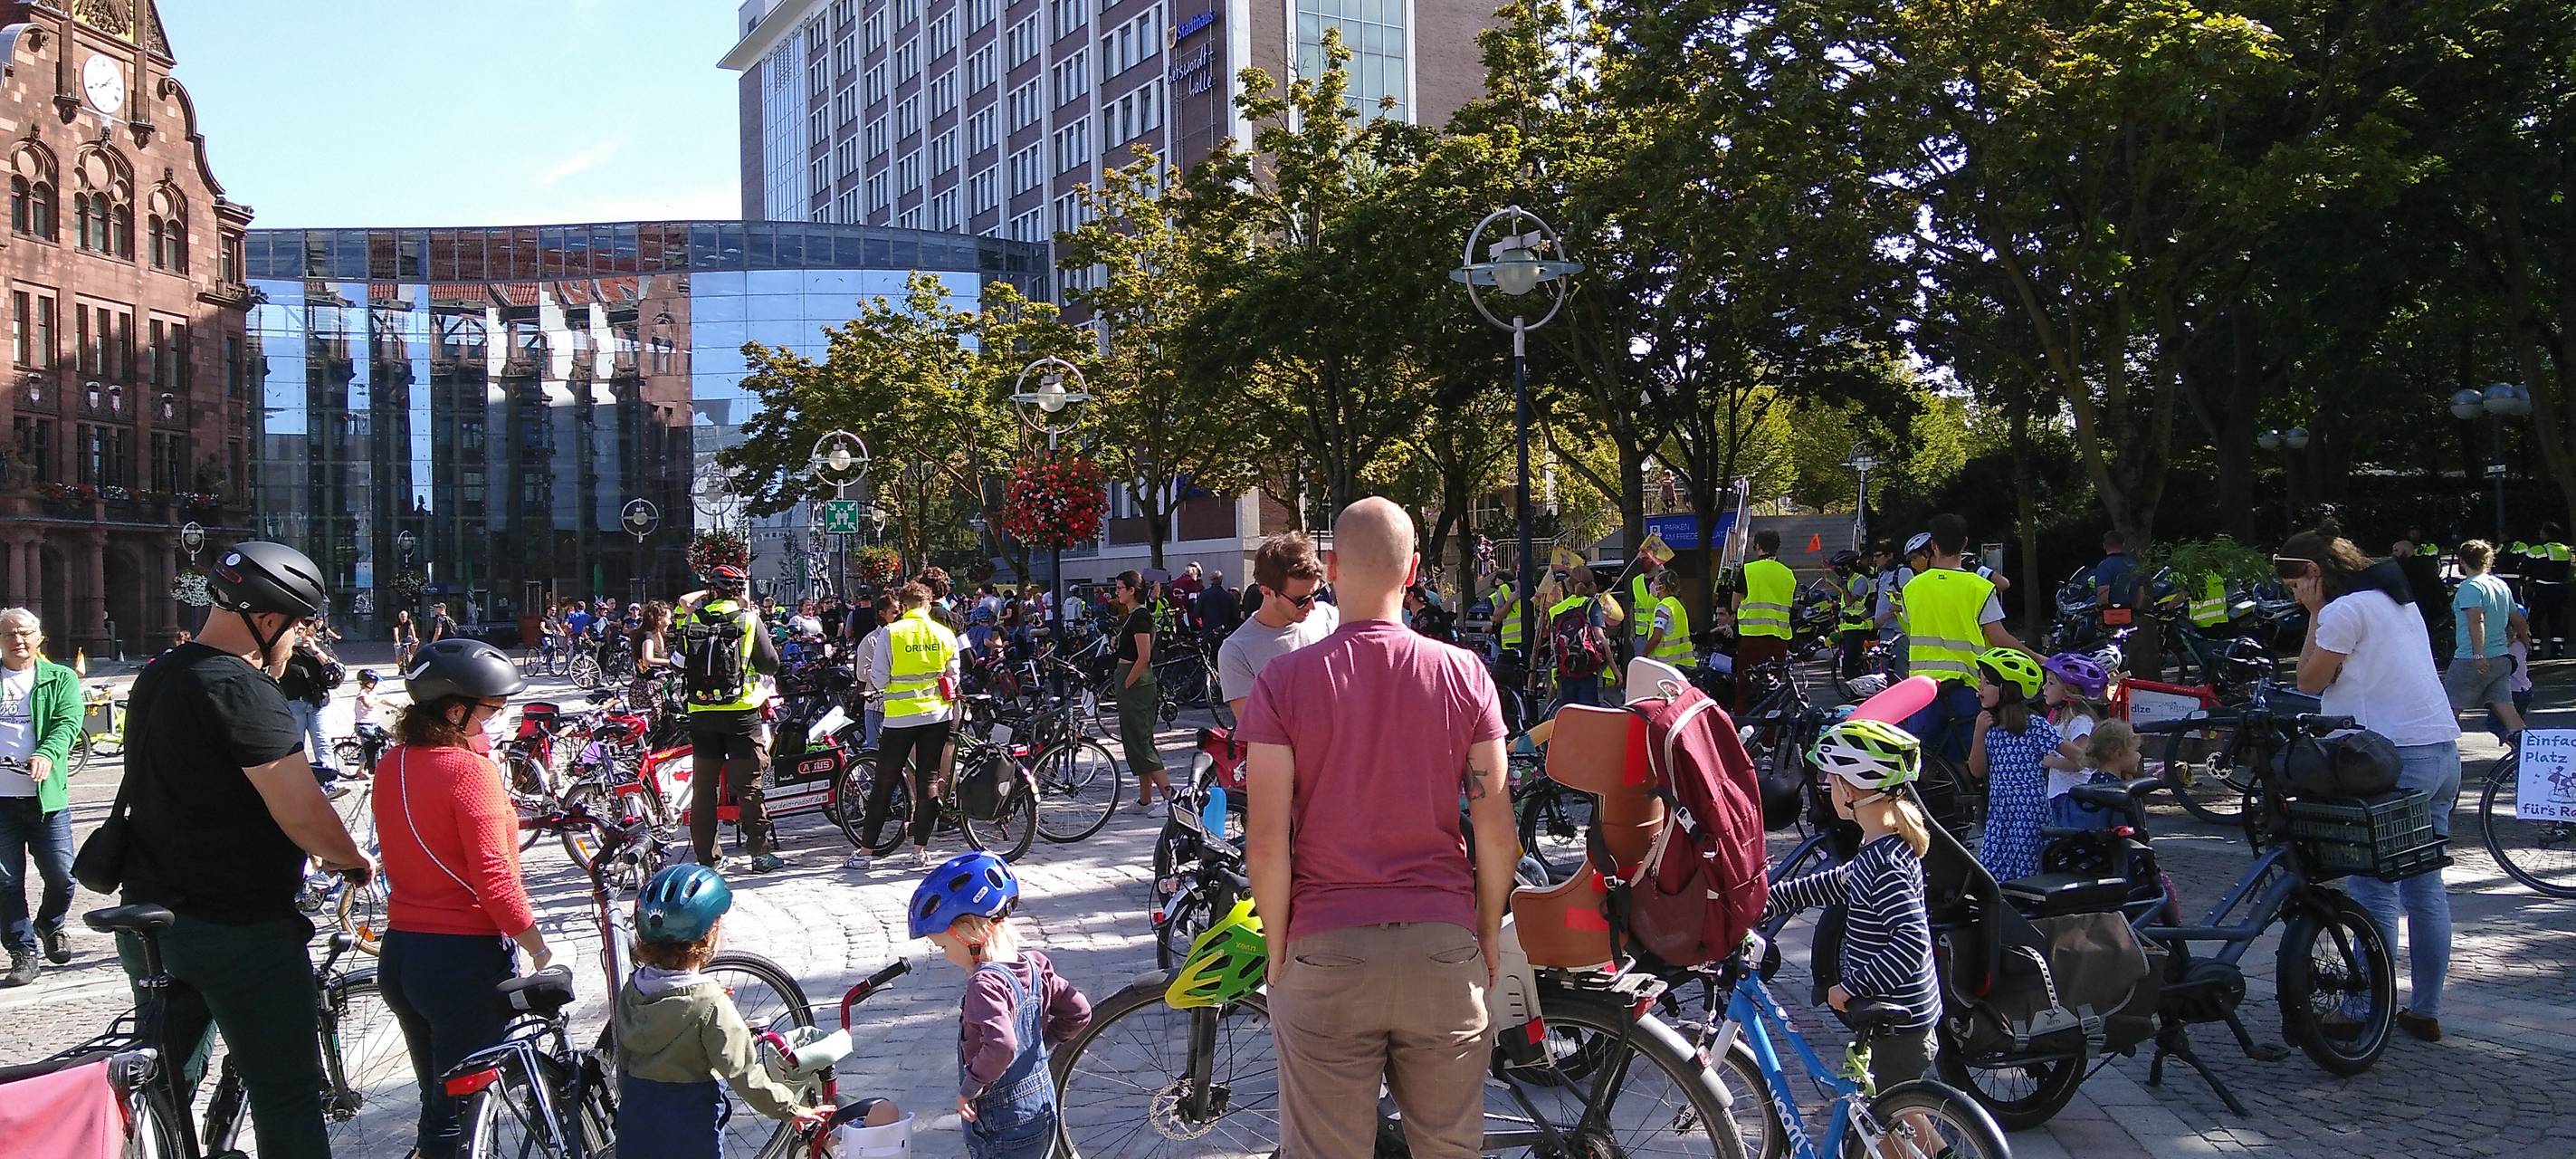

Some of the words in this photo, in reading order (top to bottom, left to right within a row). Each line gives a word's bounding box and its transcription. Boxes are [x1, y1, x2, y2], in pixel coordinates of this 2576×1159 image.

[1177, 12, 1214, 41] Stadthaus
[1188, 70, 1212, 97] halle
[2525, 752, 2568, 763] Platz
[2522, 803, 2555, 816] für's
